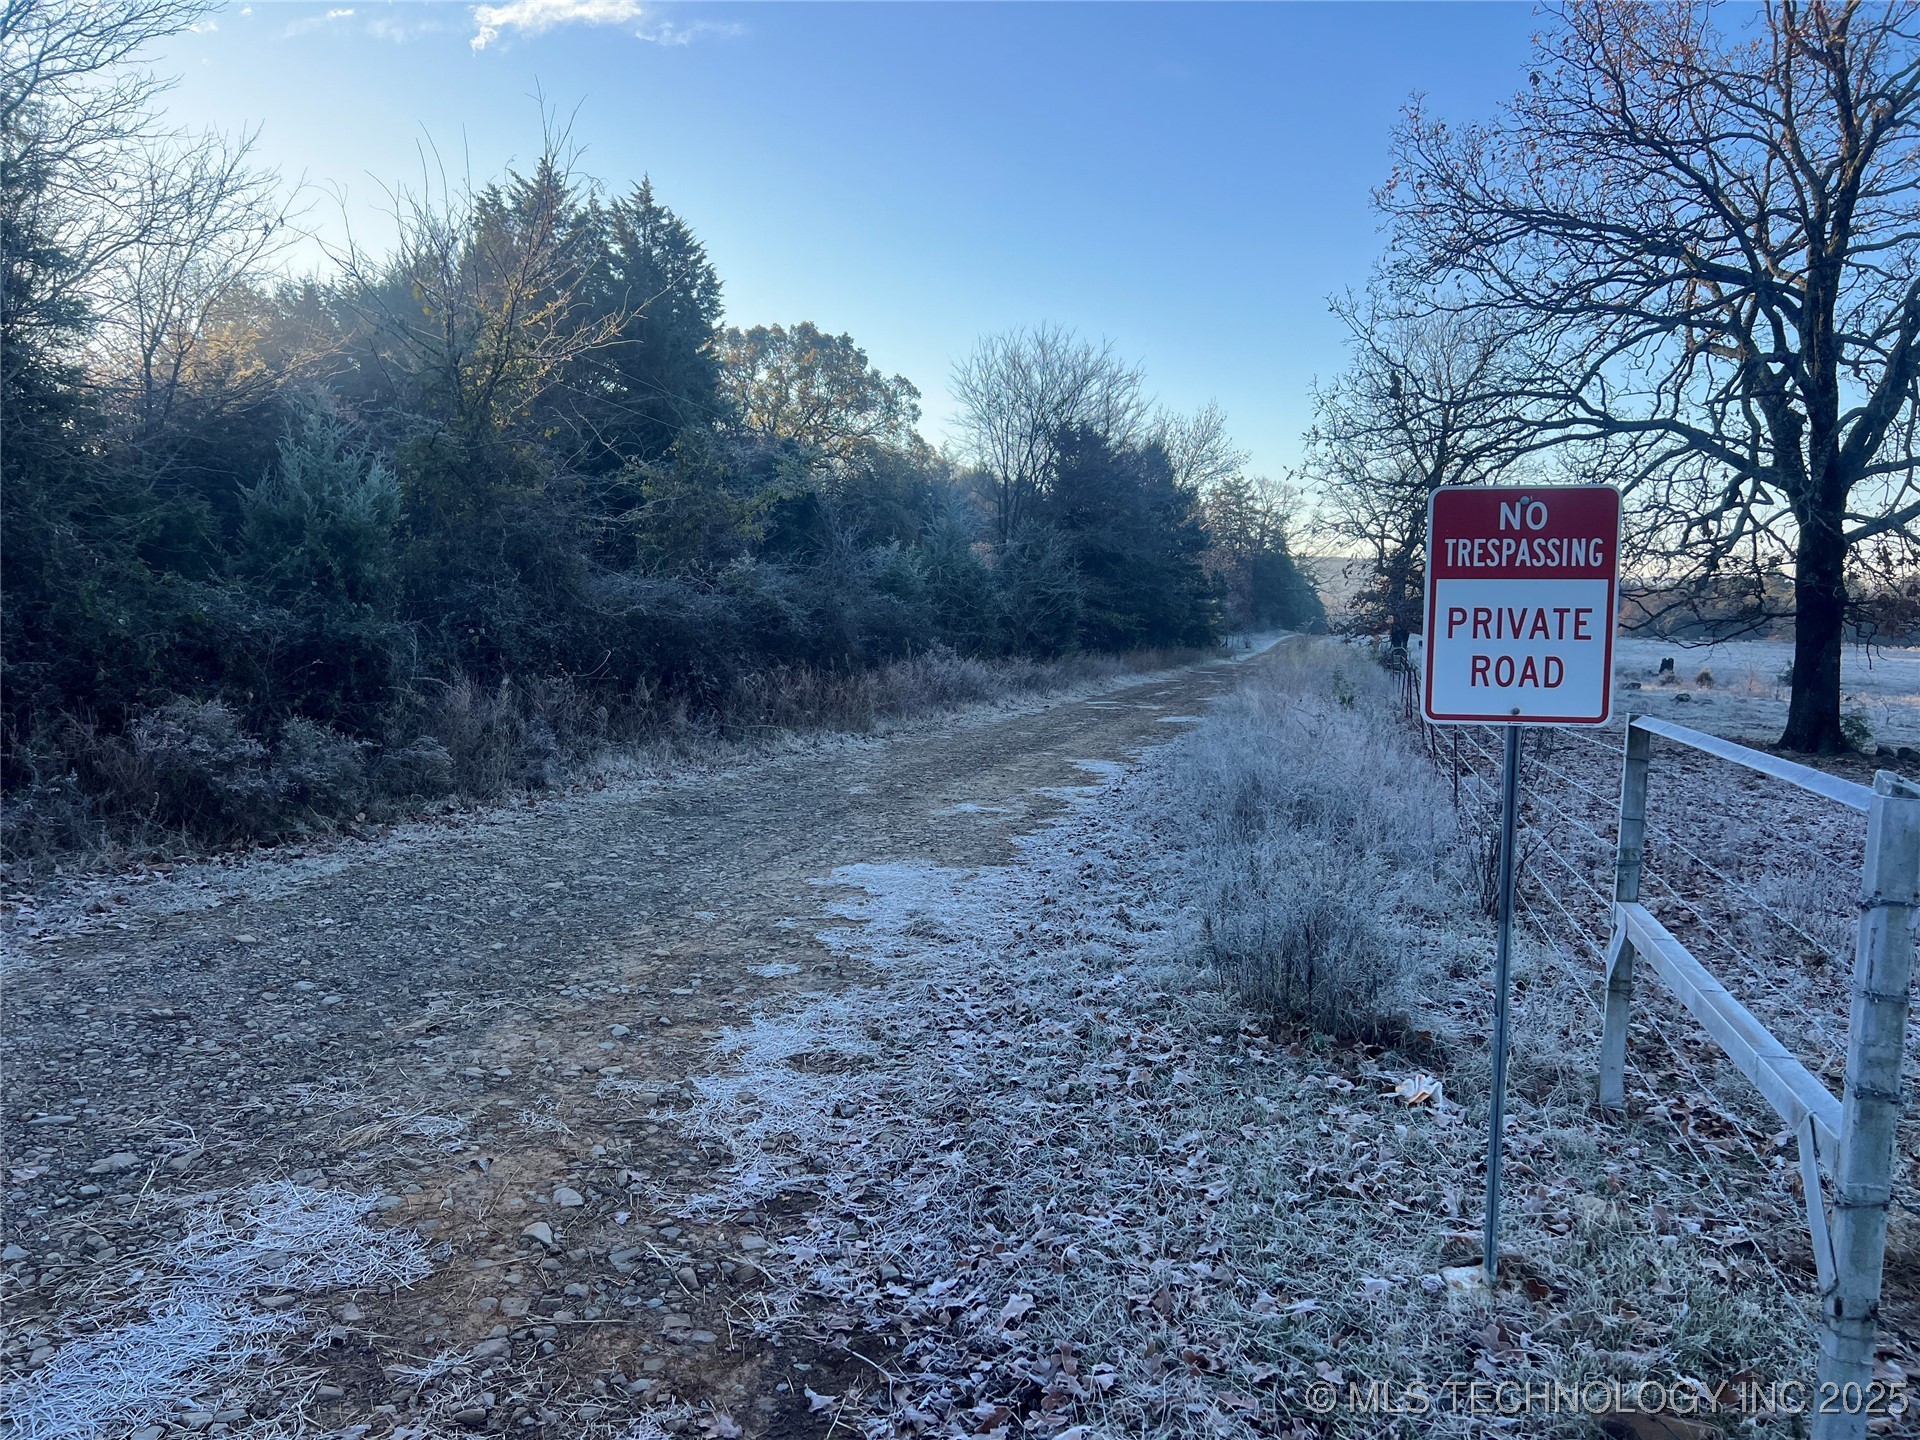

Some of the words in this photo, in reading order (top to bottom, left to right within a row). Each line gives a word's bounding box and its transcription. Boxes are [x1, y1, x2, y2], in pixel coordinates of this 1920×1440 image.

[1499, 501, 1548, 531] NO
[1444, 537, 1604, 567] TRESPASSING
[1447, 607, 1593, 641] PRIVATE
[1470, 655, 1564, 688] ROAD
